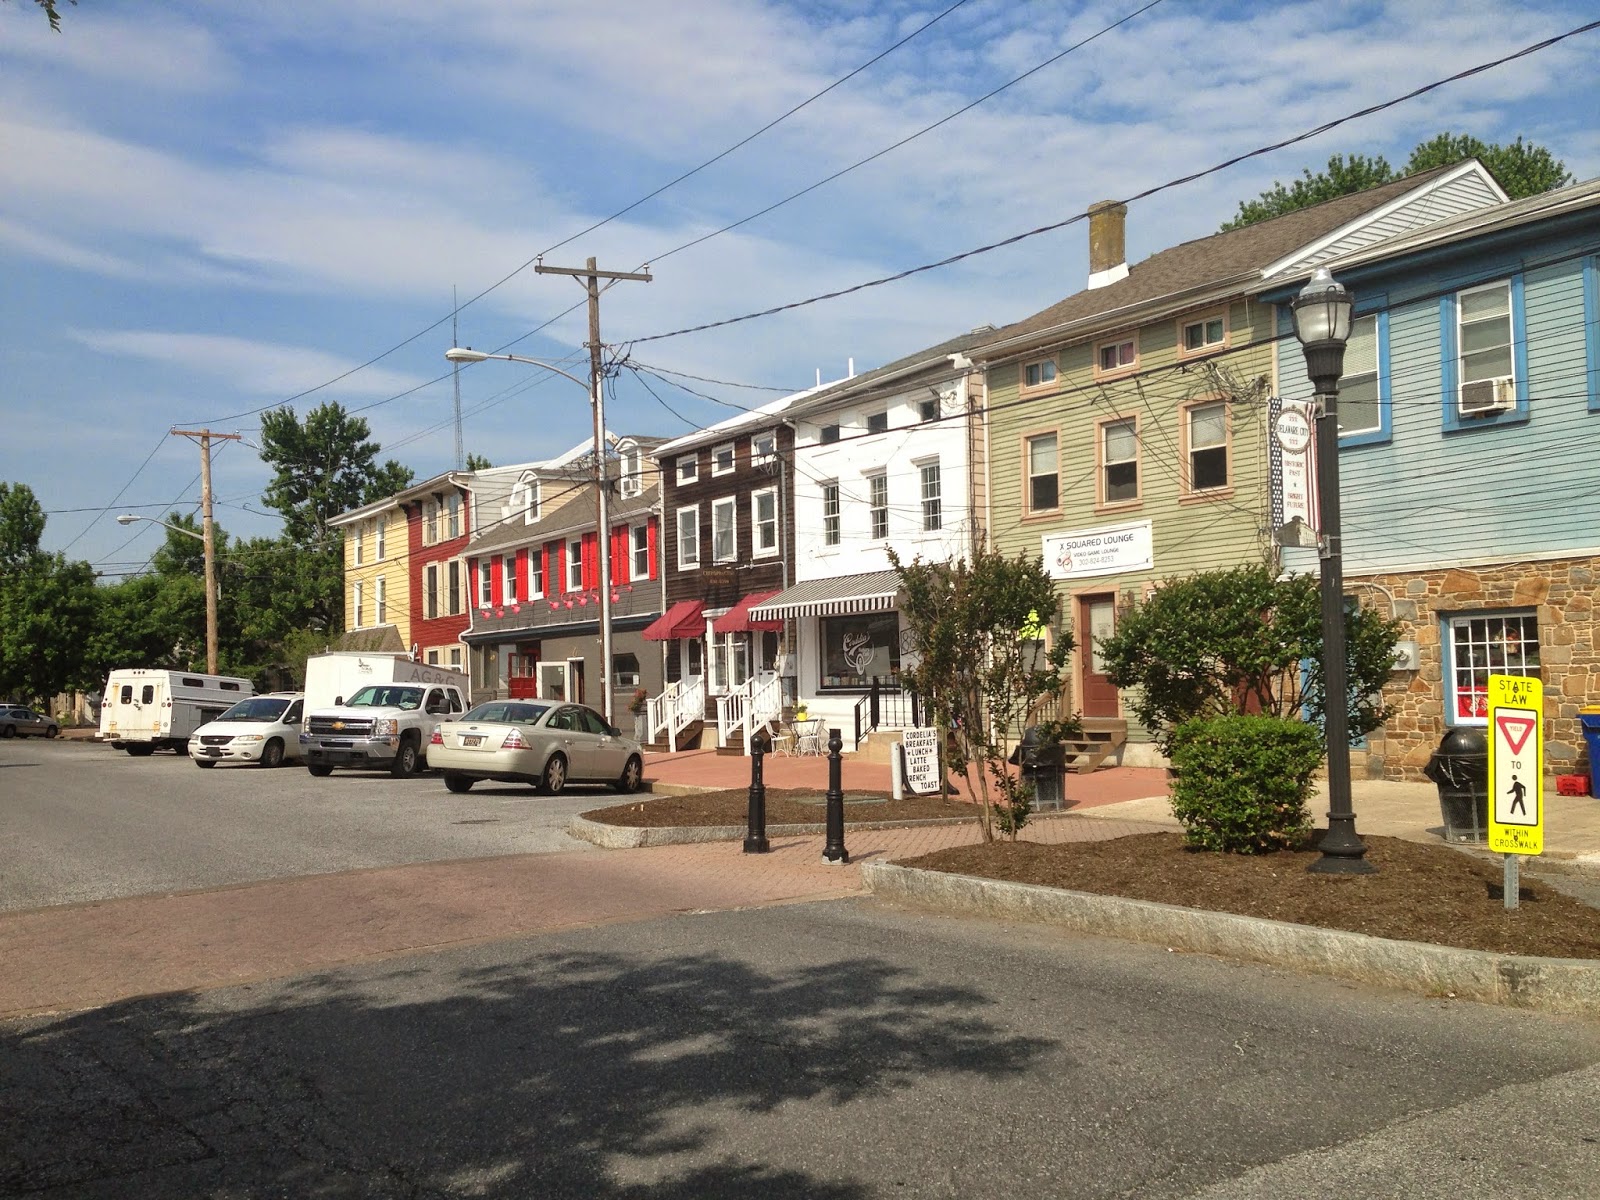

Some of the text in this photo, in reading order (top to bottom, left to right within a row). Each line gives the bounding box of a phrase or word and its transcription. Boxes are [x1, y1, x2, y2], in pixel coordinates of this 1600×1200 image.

[1277, 424, 1299, 436] DELAWARE
[1066, 538, 1102, 550] SQUARED
[1104, 533, 1133, 545] LOUNGE
[1499, 679, 1533, 693] STATE
[1504, 693, 1528, 705] LAW
[906, 730, 937, 740] CORDELIA'S
[905, 739, 936, 748] BREAKFAST
[910, 757, 927, 765] LATTE
[1511, 761, 1522, 770] TO
[912, 765, 930, 773] BAKED
[920, 781, 937, 790] TOAST
[1504, 828, 1529, 838] WITHIN
[1494, 838, 1539, 850] CROSSWALK
